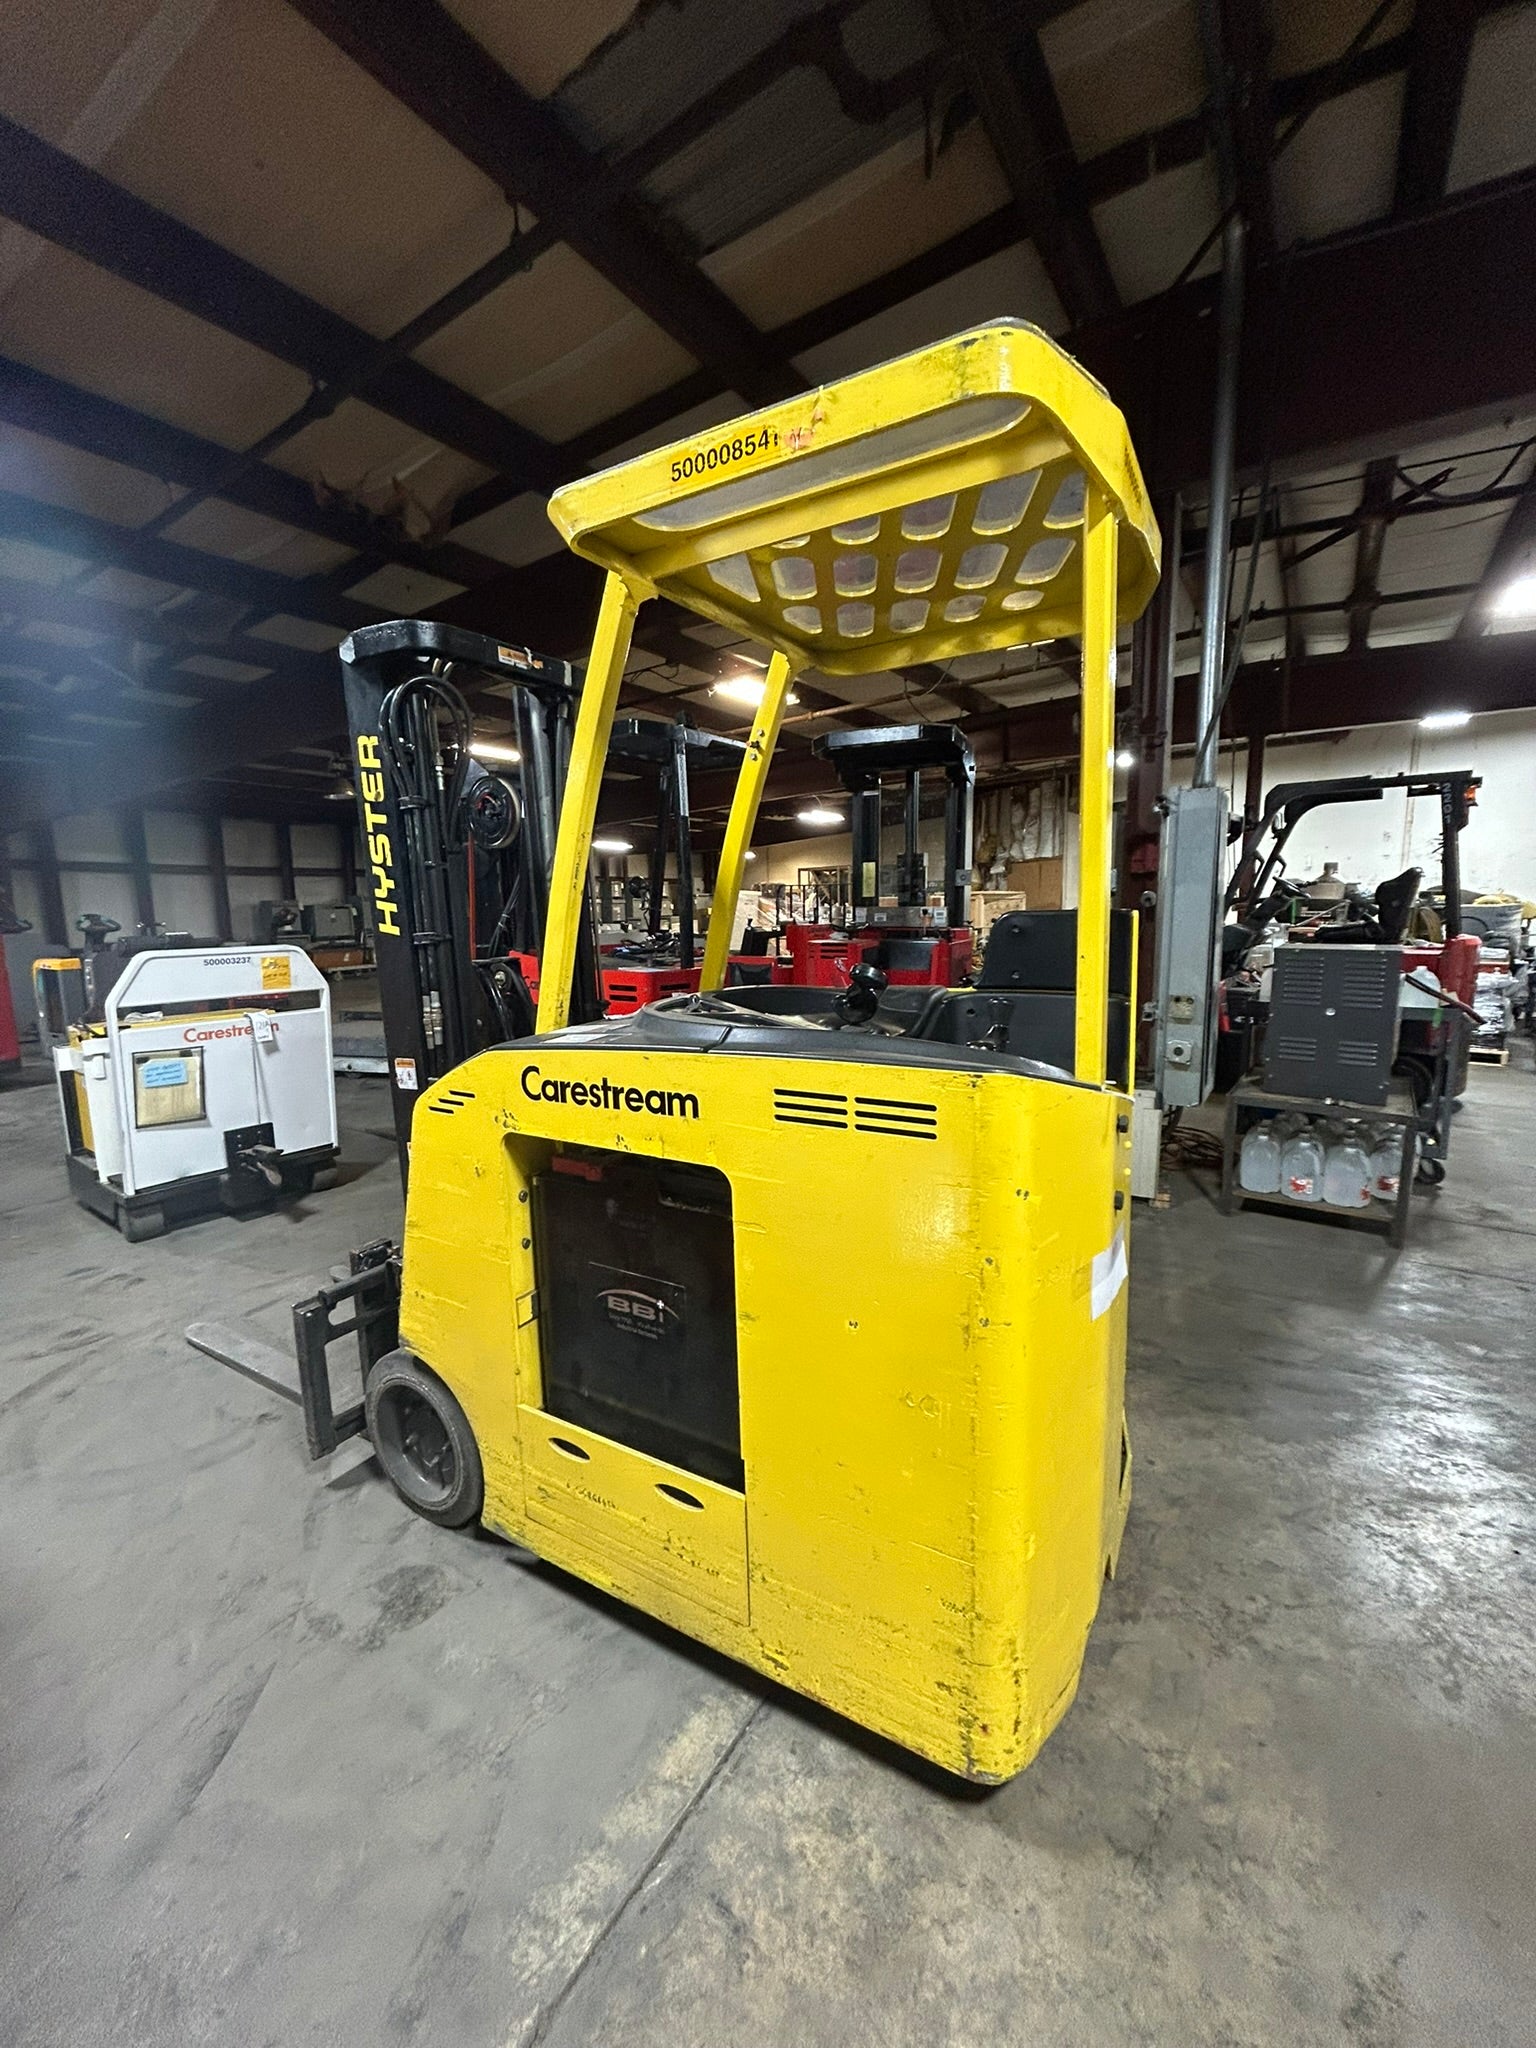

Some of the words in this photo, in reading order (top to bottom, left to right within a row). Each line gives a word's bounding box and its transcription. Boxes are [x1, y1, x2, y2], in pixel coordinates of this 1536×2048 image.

[357, 735, 401, 936] HYSTER
[203, 956, 252, 967] 500003237
[183, 1022, 279, 1043] Carestrem
[521, 1066, 700, 1119] Carestream
